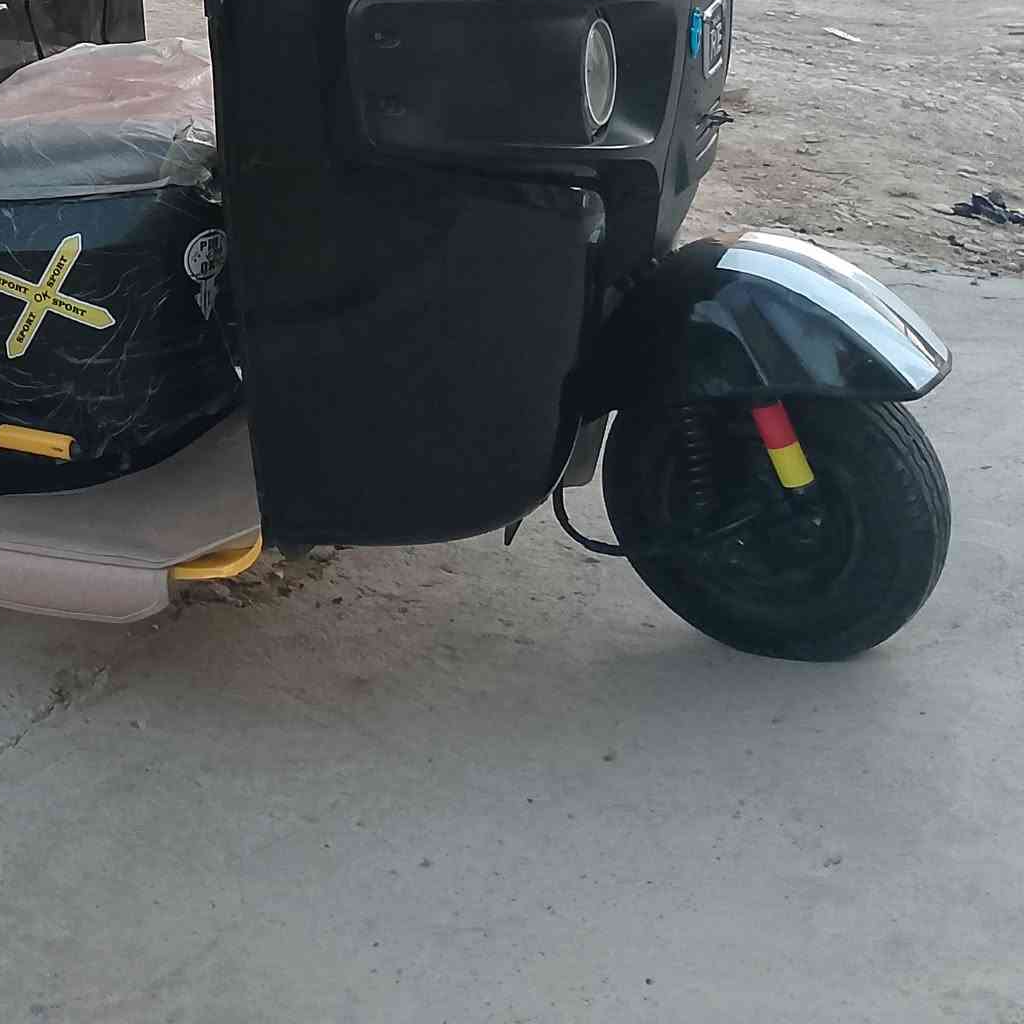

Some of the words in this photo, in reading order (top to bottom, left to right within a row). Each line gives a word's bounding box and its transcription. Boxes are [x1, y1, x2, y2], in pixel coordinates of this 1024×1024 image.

[46, 256, 68, 288] SPORT
[33, 290, 51, 303] OK
[51, 298, 87, 316] SPORT
[16, 311, 37, 343] SPORT
